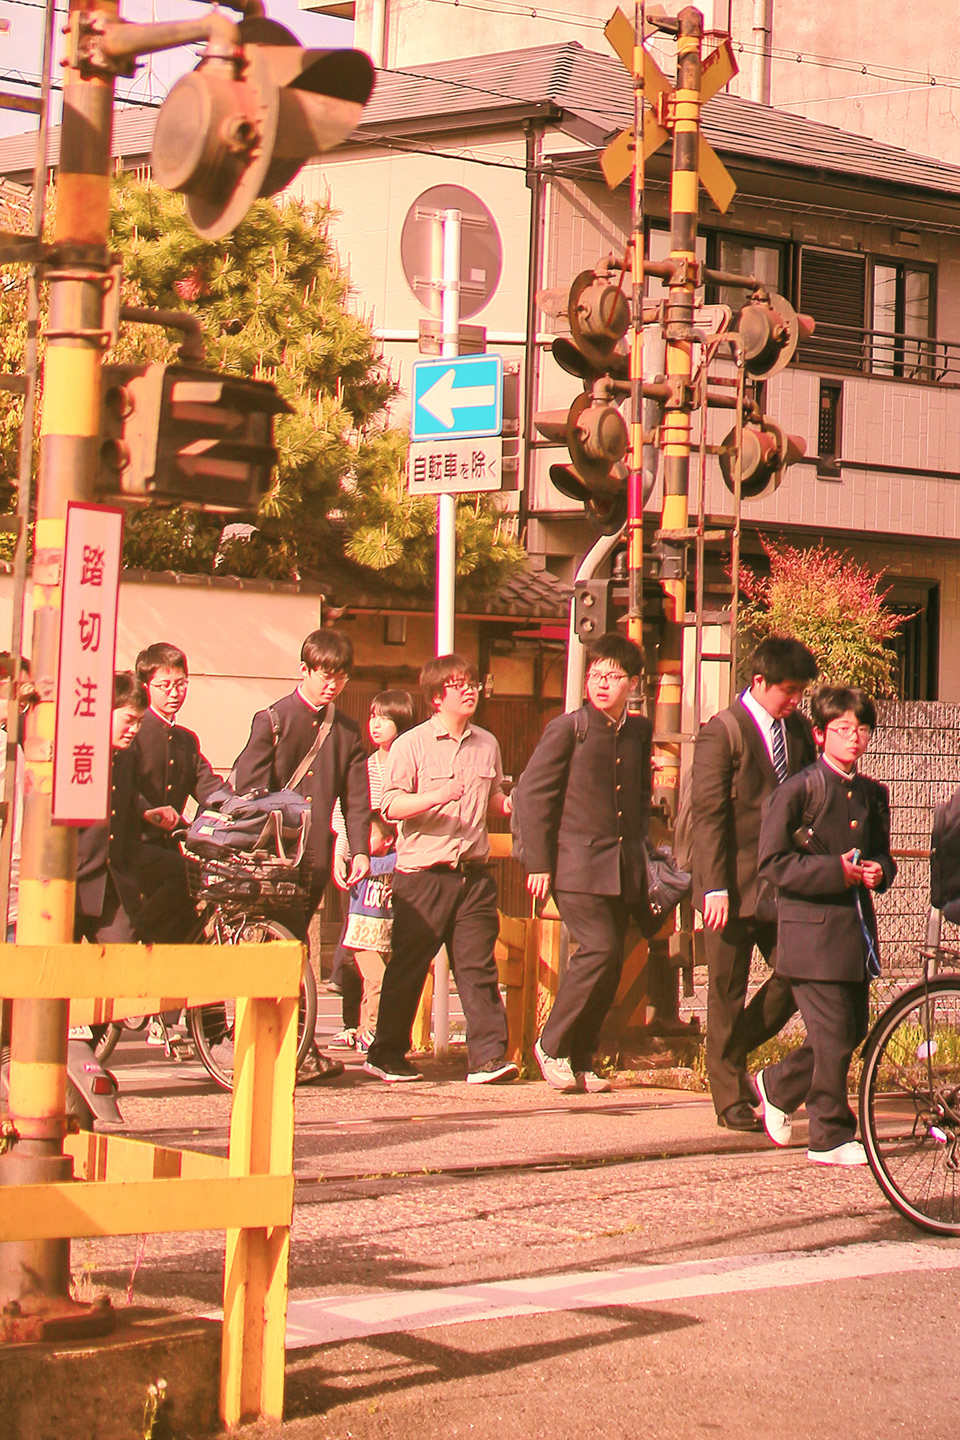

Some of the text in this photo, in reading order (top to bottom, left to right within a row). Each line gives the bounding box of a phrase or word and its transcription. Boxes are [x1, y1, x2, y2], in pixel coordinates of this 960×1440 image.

[414, 449, 497, 482] 自転車を除く
[71, 544, 106, 785] 踏切注意
